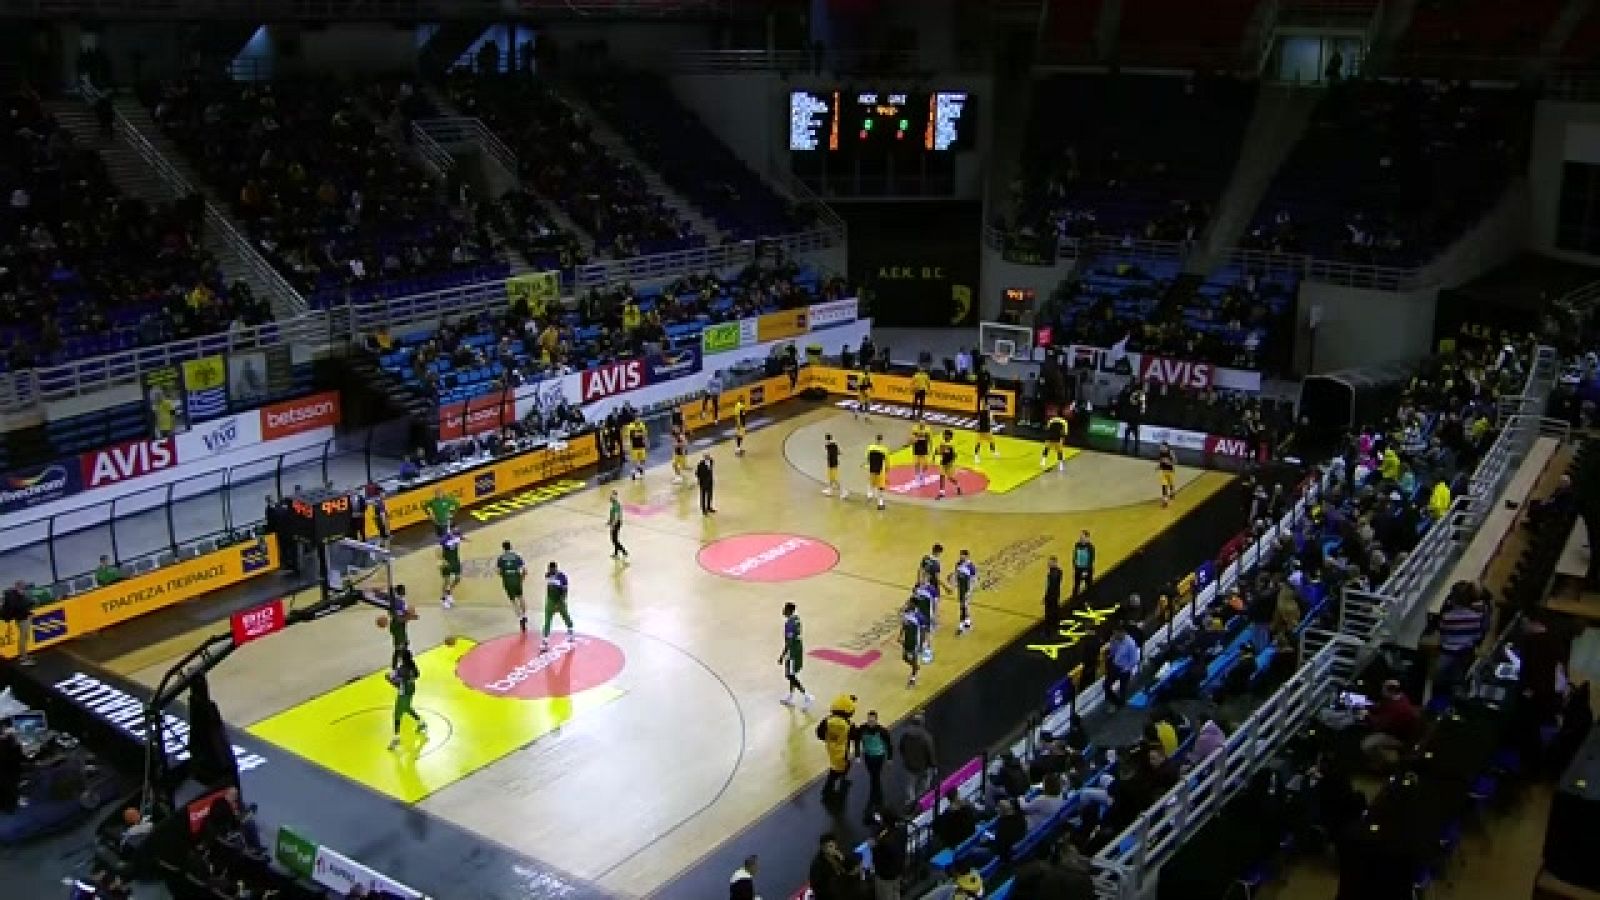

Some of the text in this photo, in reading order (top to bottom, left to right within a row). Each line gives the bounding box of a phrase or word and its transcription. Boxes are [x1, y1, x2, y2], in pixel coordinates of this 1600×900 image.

[587, 361, 642, 399] AVIS
[1145, 358, 1209, 389] AVIS
[266, 400, 335, 428] betsson
[91, 440, 171, 486] AVIS
